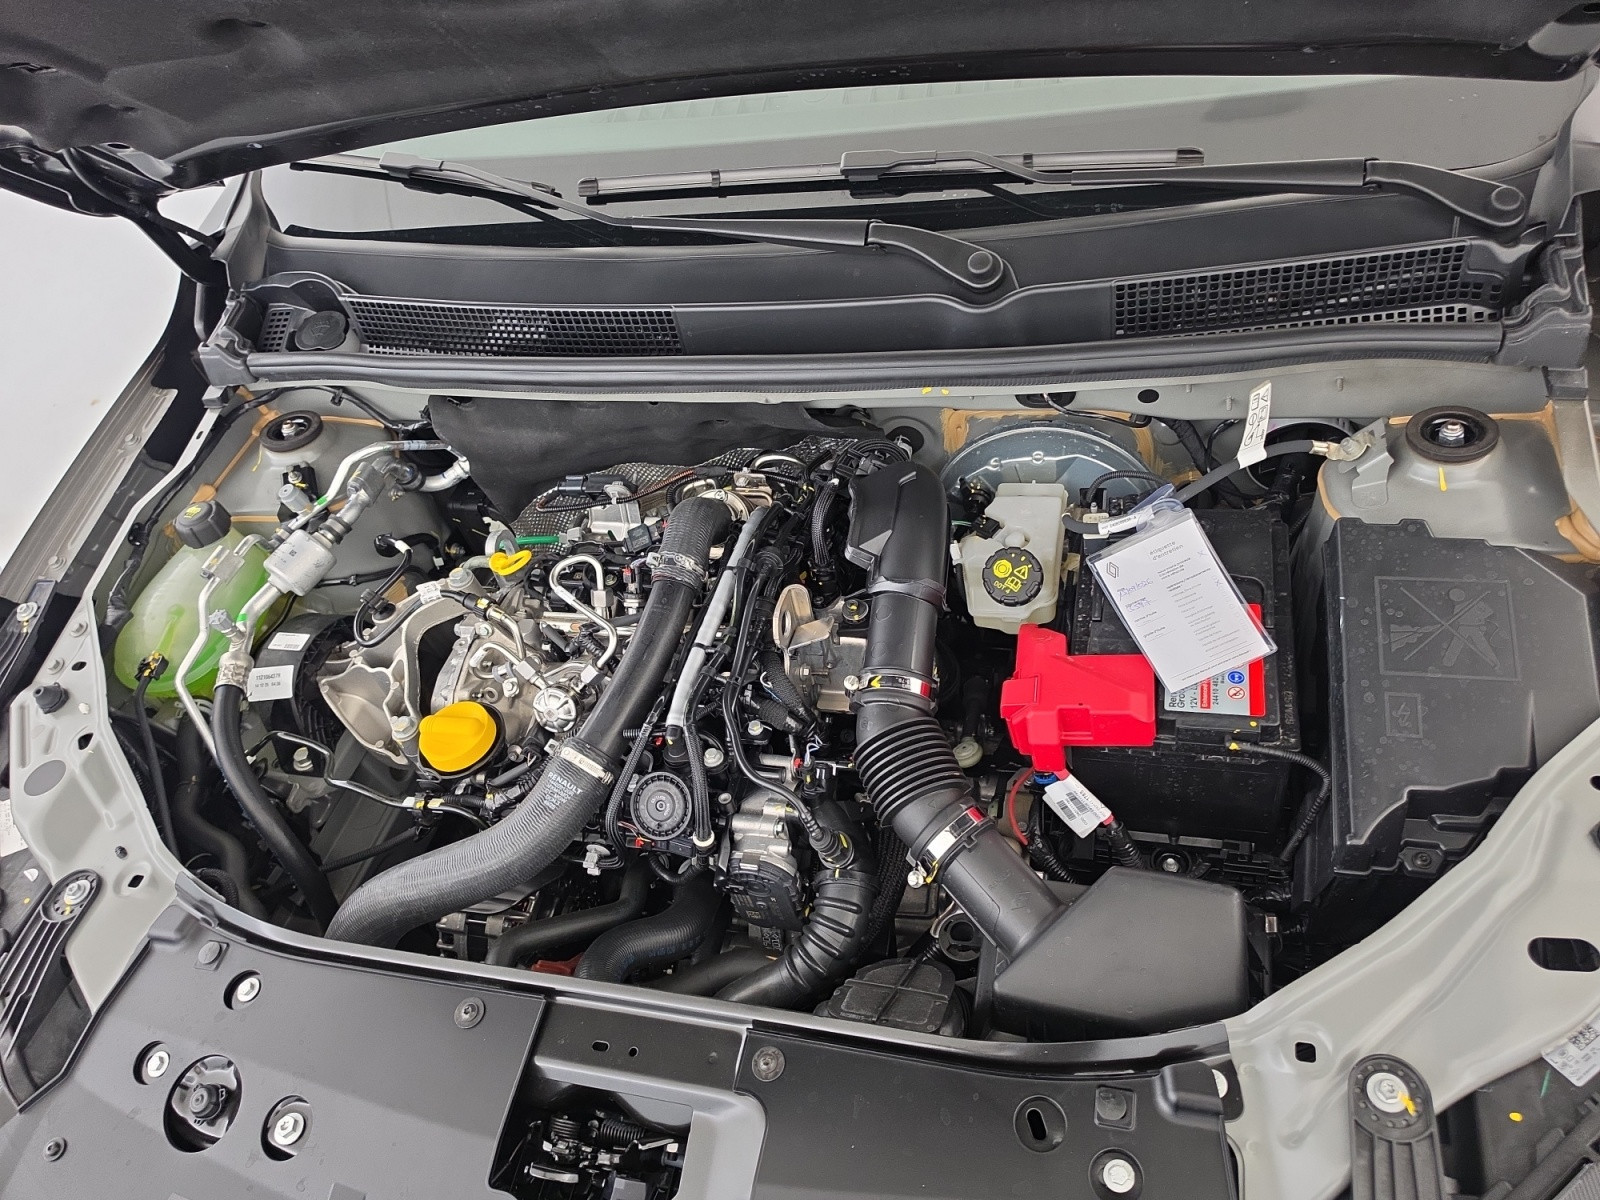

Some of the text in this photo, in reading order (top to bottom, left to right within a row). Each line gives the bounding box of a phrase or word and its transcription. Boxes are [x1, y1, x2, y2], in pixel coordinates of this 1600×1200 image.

[994, 580, 1007, 590] DOT
[1190, 696, 1198, 709] 12V
[548, 771, 583, 795] RENAULT
